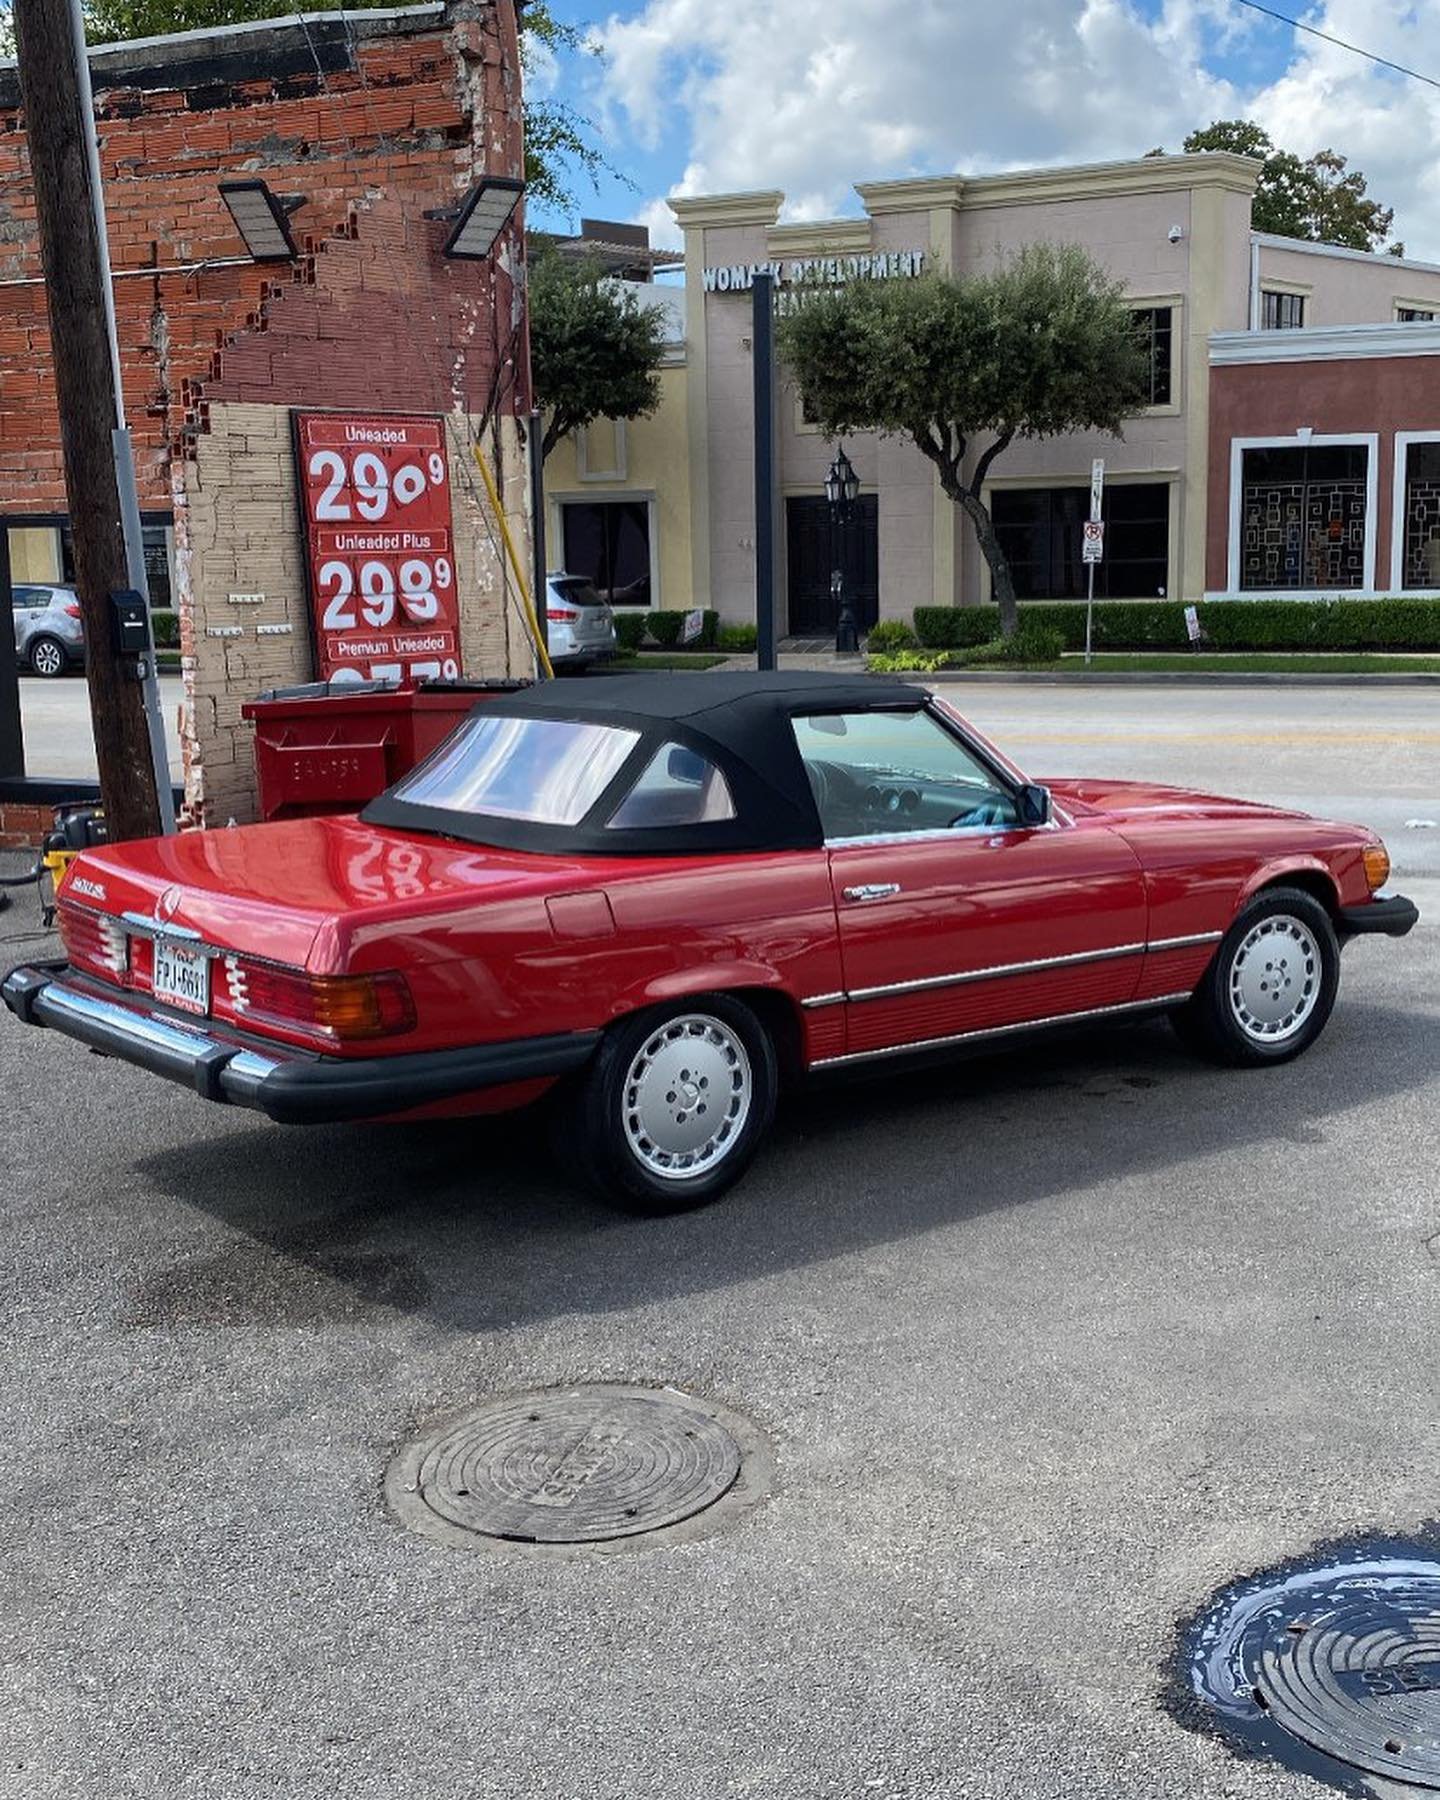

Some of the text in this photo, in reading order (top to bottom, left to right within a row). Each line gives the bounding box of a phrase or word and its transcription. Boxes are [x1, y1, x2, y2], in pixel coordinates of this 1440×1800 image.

[790, 251, 924, 284] DEVELOPMENT
[345, 425, 407, 442] Unleaded
[335, 533, 431, 550] Unleaded Plus
[337, 634, 446, 657] Premium Unleaded
